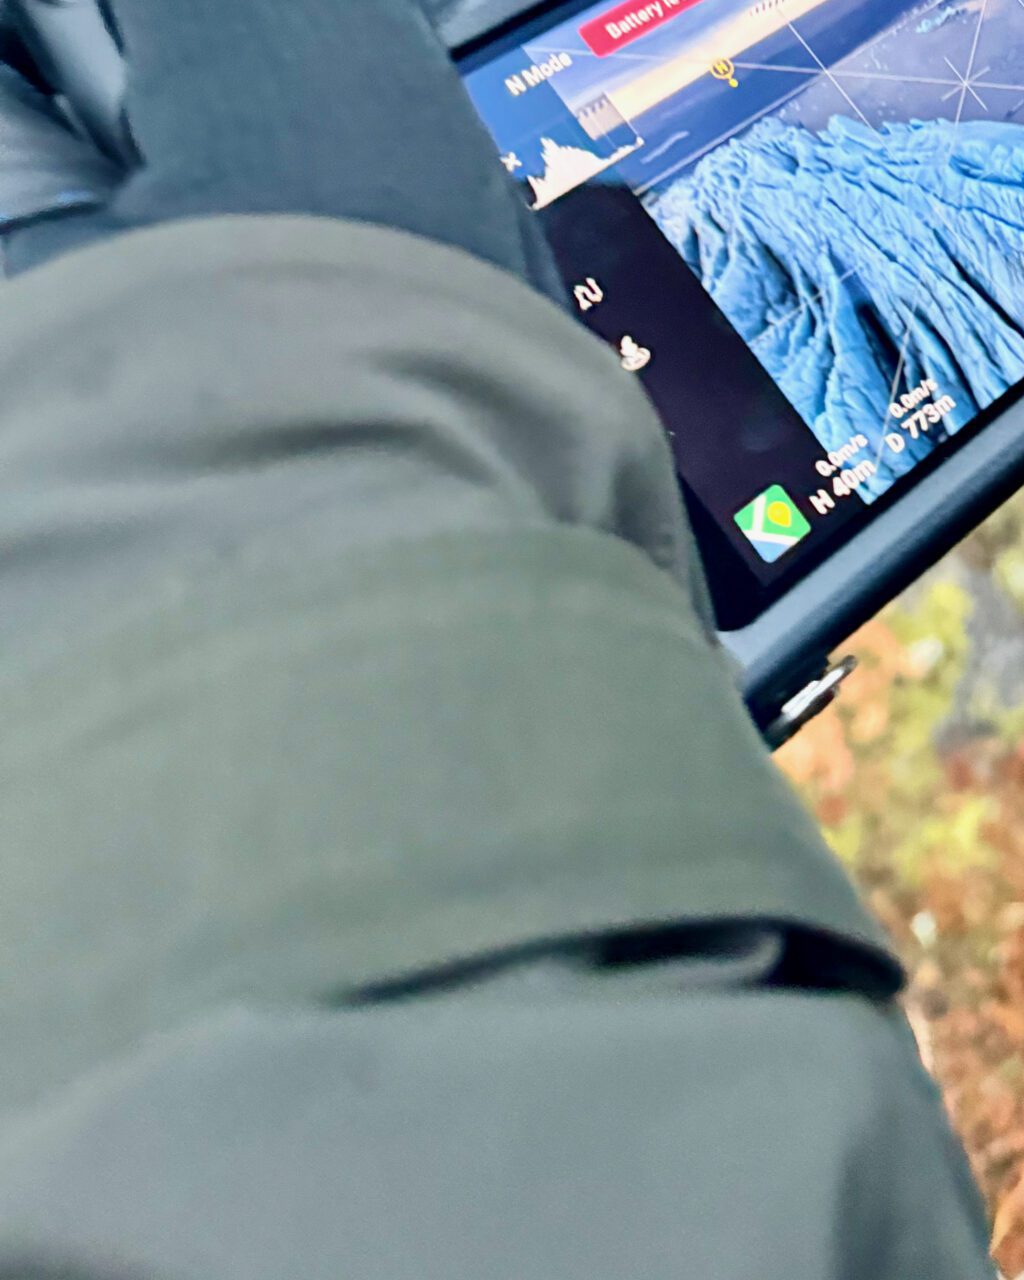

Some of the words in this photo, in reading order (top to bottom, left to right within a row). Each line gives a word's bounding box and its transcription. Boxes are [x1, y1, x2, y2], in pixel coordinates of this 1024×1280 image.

[604, 2, 664, 40] Battery
[504, 74, 527, 97] N
[524, 51, 573, 88] Mode
[889, 378, 937, 418] 0.0m/s
[884, 432, 905, 454] D
[900, 395, 956, 439] 773m
[815, 434, 868, 477] 0.0m/s
[809, 489, 835, 515] H
[832, 460, 877, 496] 40m
